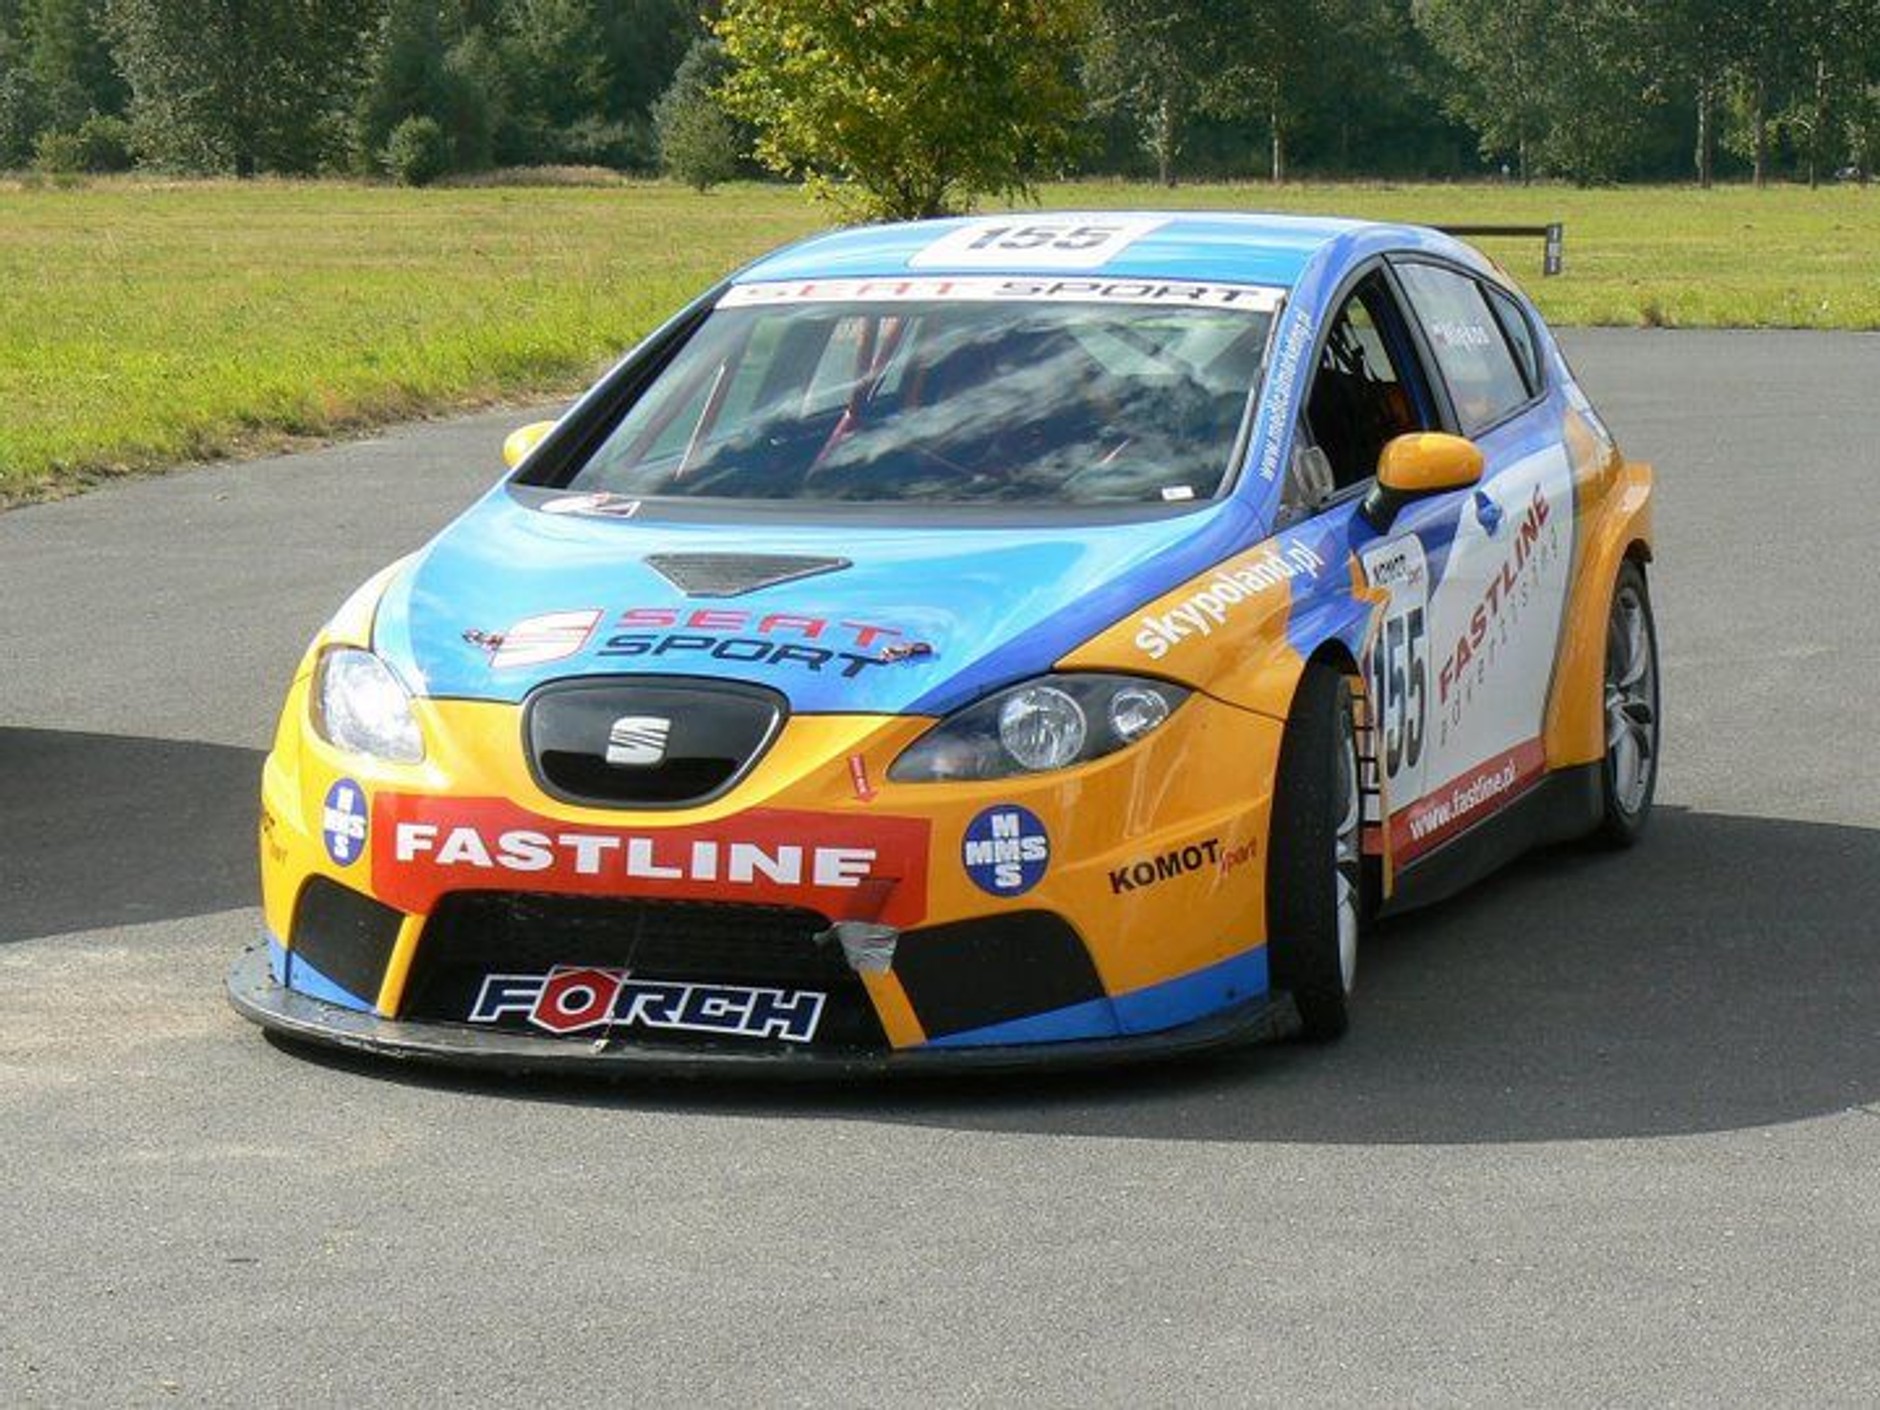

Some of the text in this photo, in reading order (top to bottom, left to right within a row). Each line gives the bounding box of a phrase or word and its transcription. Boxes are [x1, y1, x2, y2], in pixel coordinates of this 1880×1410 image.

[967, 225, 1123, 250] 155
[995, 281, 1257, 301] SPORT
[1135, 537, 1325, 660] skypoland.pl
[1439, 482, 1551, 705] FASTLINE
[597, 632, 888, 679] SPORT
[615, 607, 902, 648] SEAT
[1373, 606, 1426, 779] 155
[1408, 757, 1517, 840] www.fastline.pl
[395, 821, 878, 888] FASTLINE
[1107, 838, 1218, 895] KOMOT
